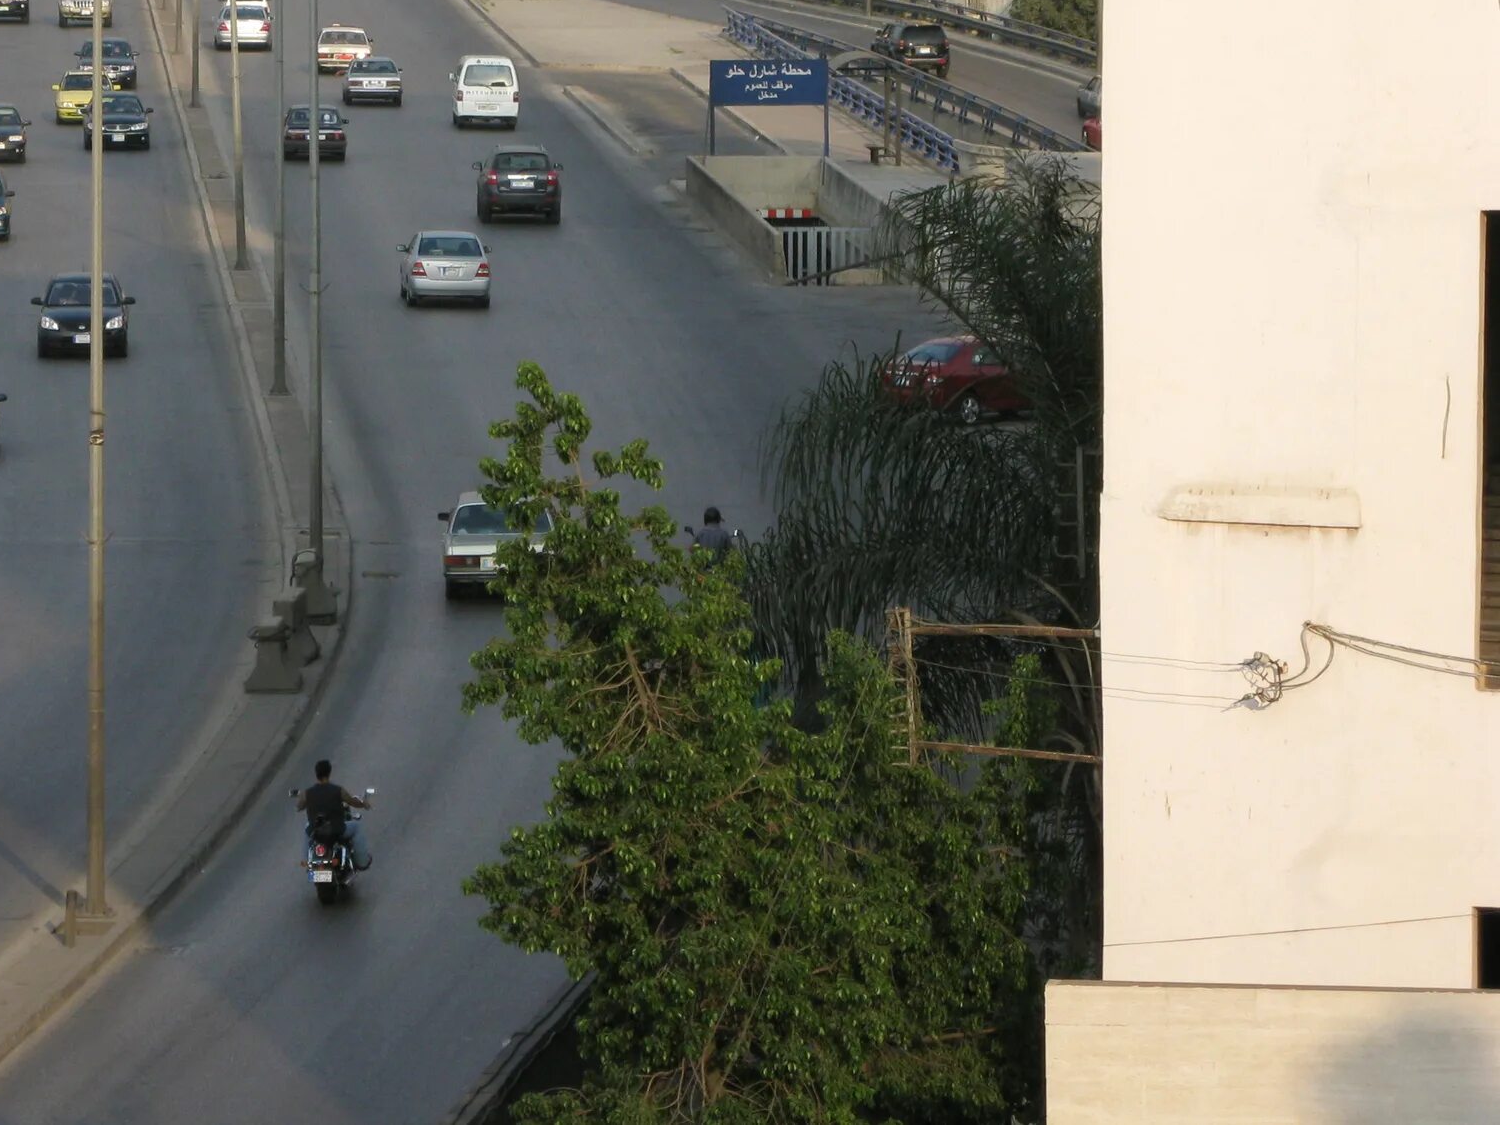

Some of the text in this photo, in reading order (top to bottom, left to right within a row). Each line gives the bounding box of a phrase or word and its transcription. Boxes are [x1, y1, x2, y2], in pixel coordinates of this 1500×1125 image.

[725, 62, 812, 79] محطة شارل حلو
[771, 80, 793, 91] موقف
[757, 91, 778, 100] مدخل
